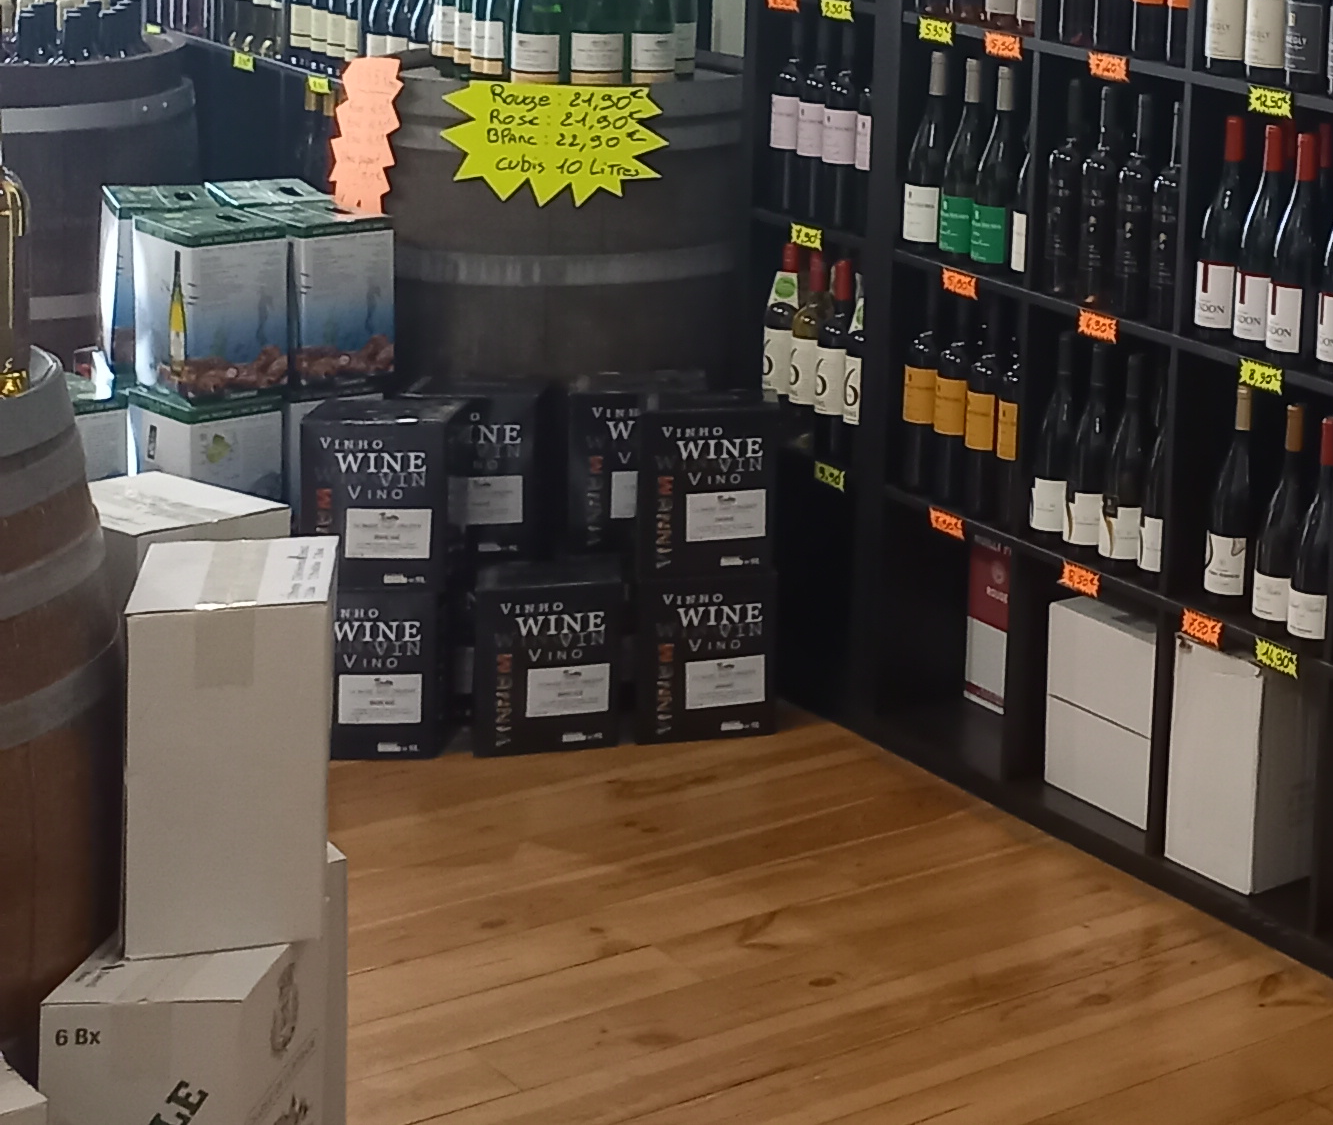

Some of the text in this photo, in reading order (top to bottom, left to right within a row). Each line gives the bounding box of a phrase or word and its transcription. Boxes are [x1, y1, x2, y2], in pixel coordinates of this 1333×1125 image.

[489, 83, 647, 112] Rouge 21,90€
[558, 109, 642, 131] 21,90€
[554, 129, 648, 152] 22,90€
[555, 157, 583, 175] 10
[676, 437, 764, 461] WINE
[334, 451, 427, 474] WINE
[340, 608, 379, 619] NHO
[514, 610, 606, 637] WINE
[676, 602, 764, 628] WINE
[333, 621, 422, 643] WINE
[54, 1026, 102, 1047] 6 Bx
